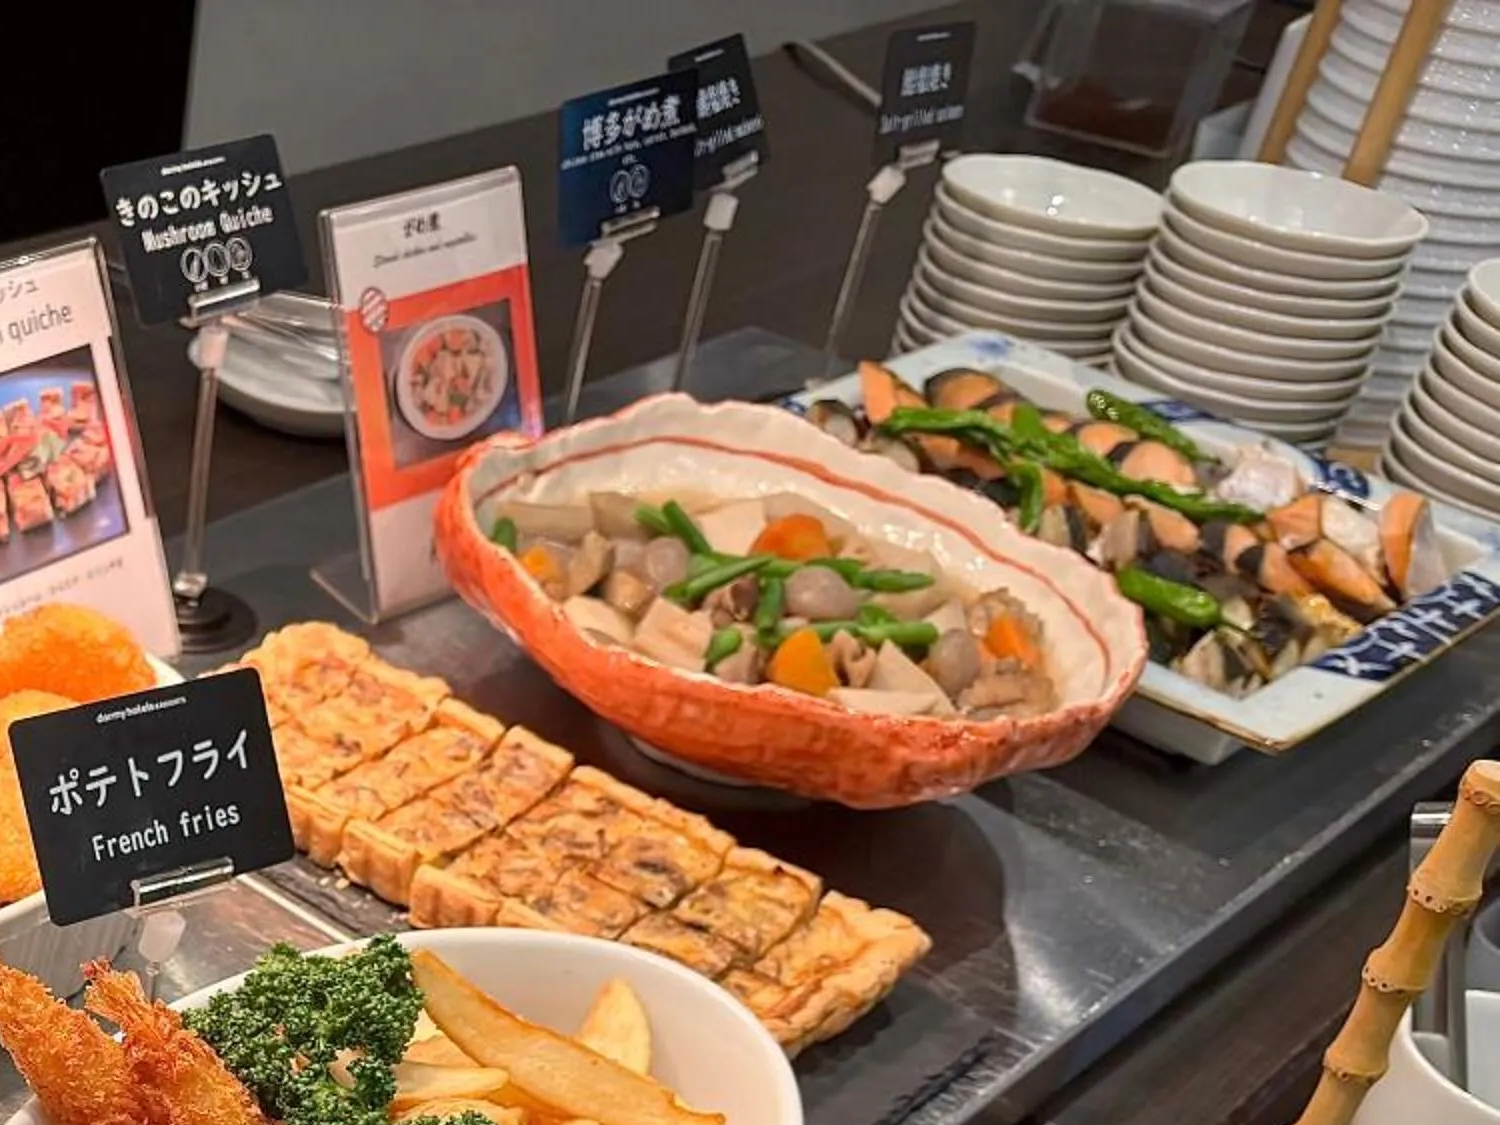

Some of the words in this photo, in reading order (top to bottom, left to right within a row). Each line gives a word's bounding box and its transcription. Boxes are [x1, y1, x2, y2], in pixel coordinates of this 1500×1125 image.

[115, 171, 284, 228] きのこのキッシュ
[7, 303, 73, 346] quiche
[49, 728, 249, 816] ポテトフライ
[91, 819, 170, 862] French
[179, 803, 241, 838] fries
